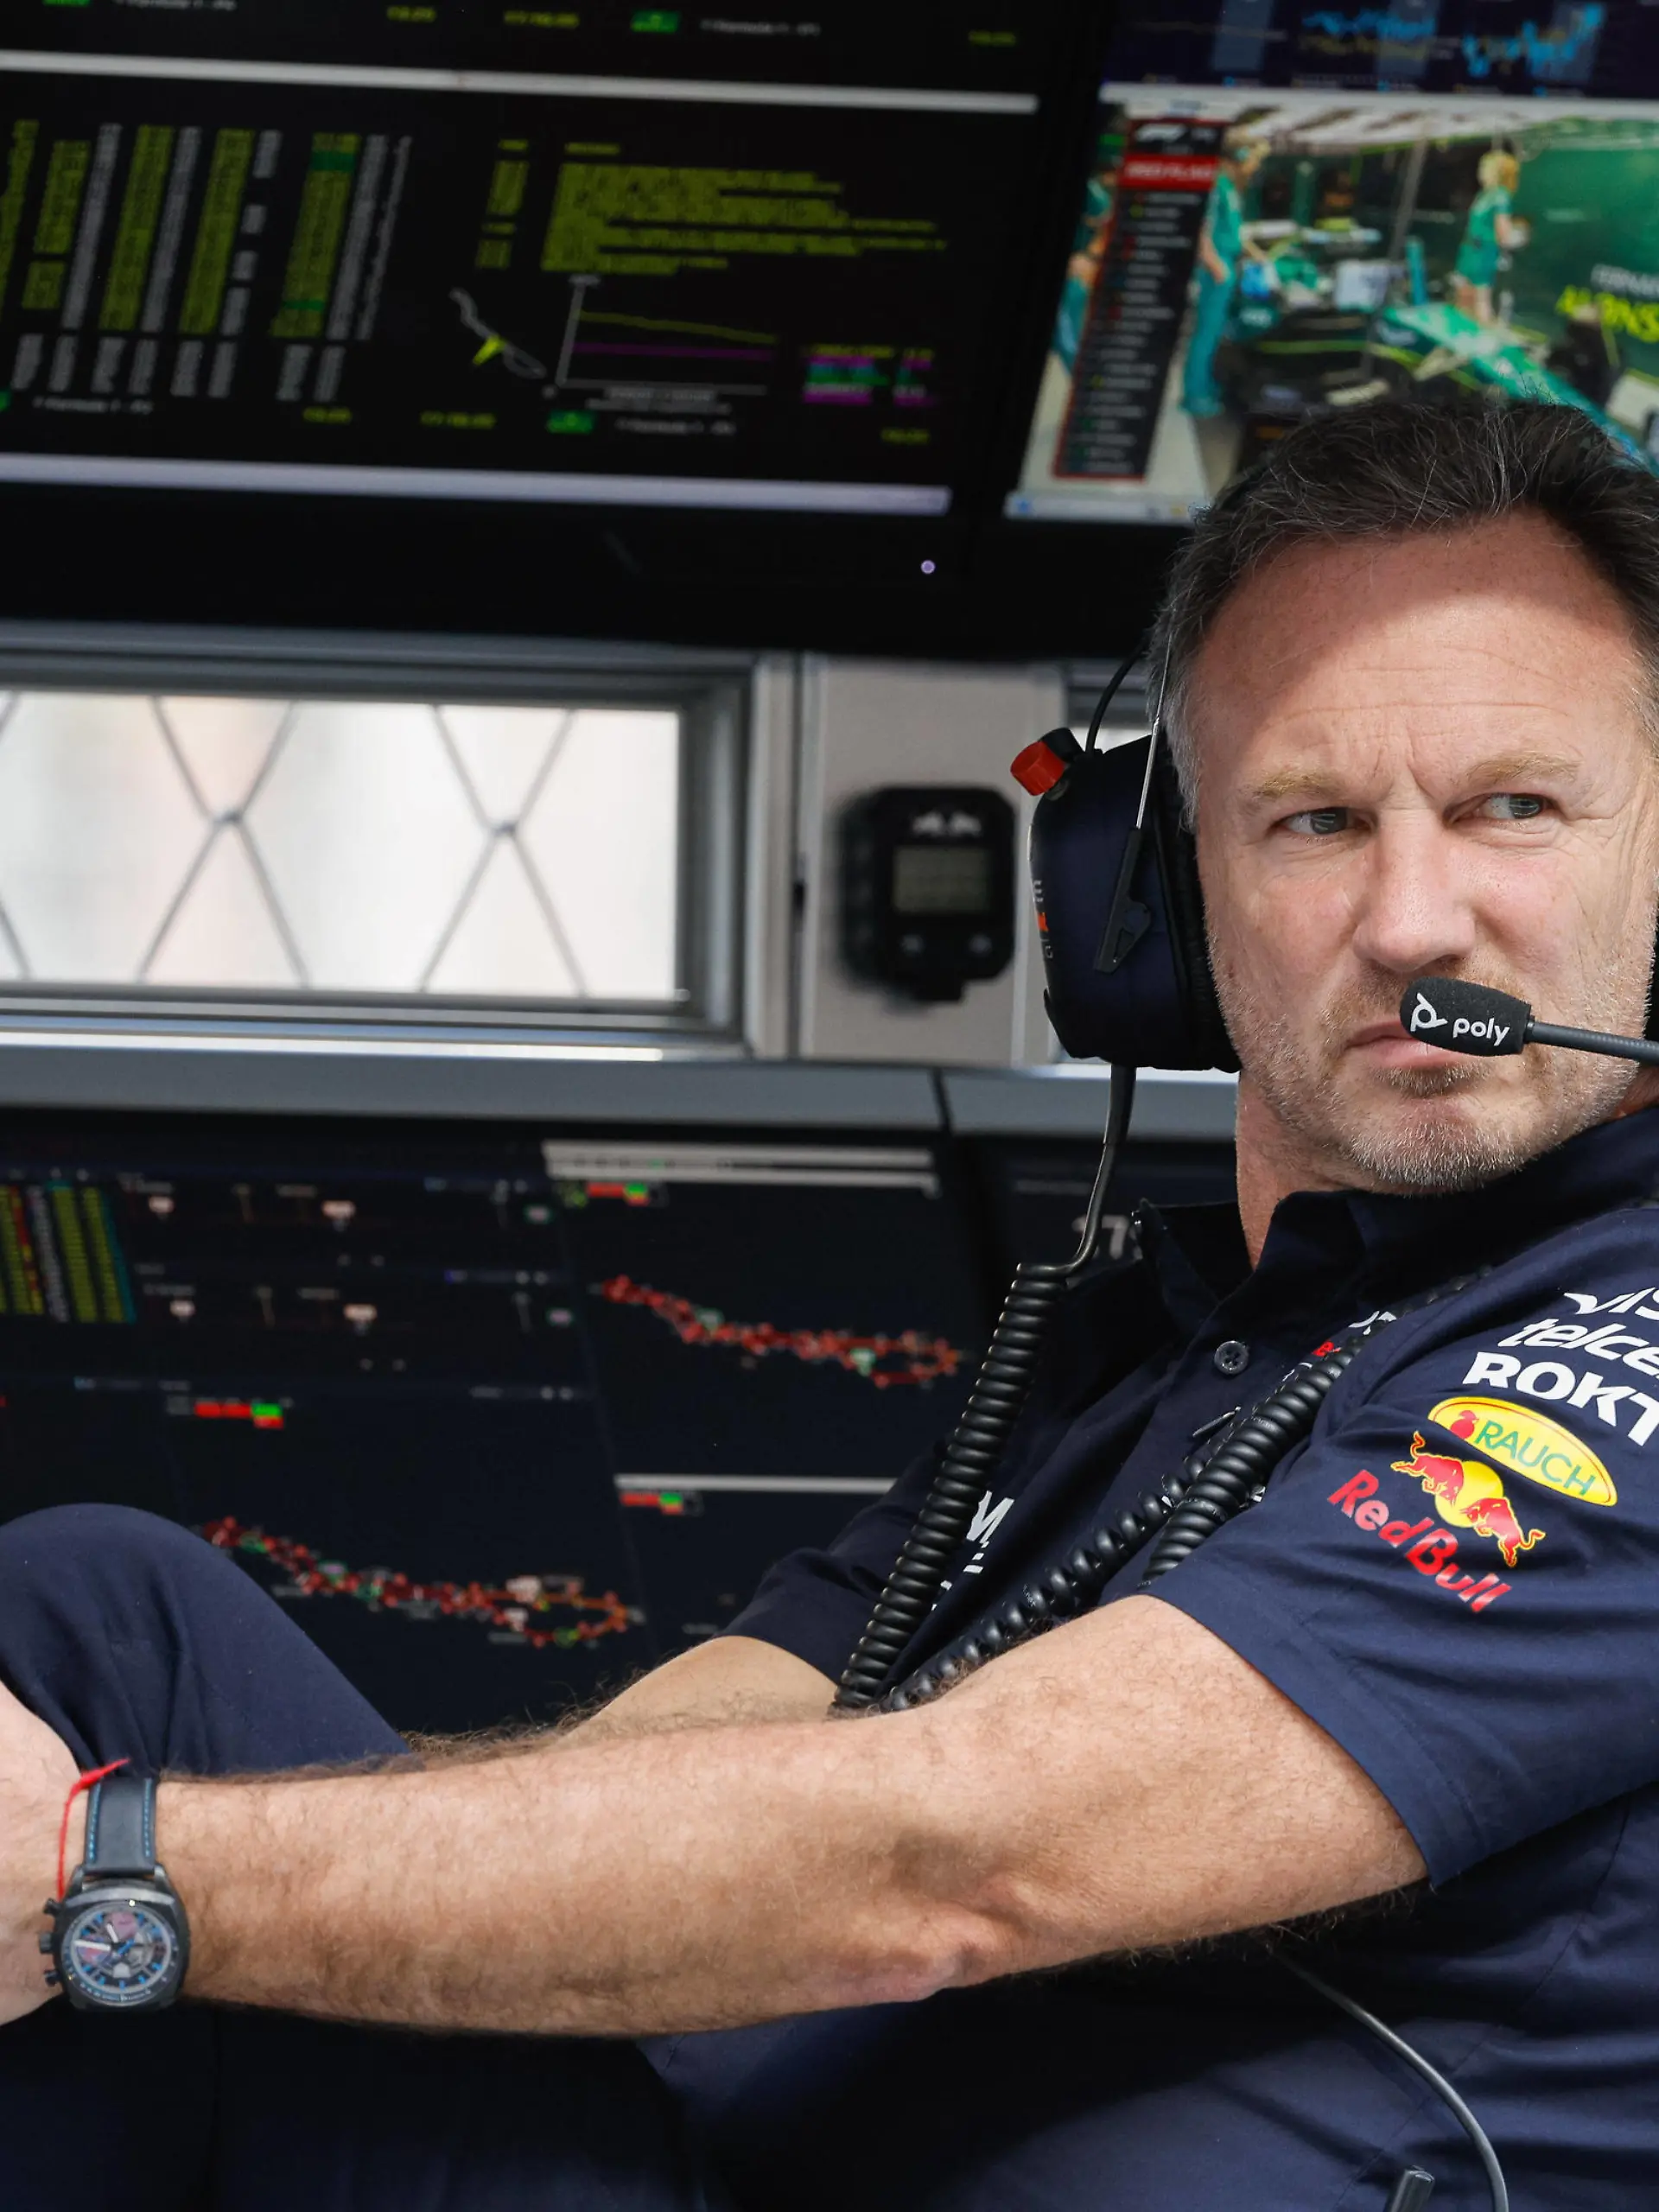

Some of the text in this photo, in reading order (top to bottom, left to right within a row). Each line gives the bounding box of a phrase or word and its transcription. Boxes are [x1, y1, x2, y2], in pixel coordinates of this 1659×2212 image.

[1452, 1017, 1510, 1046] poly
[1497, 1319, 1659, 1380] telce
[1462, 1351, 1659, 1446] ROKT
[1474, 1420, 1596, 1496] RAUCH
